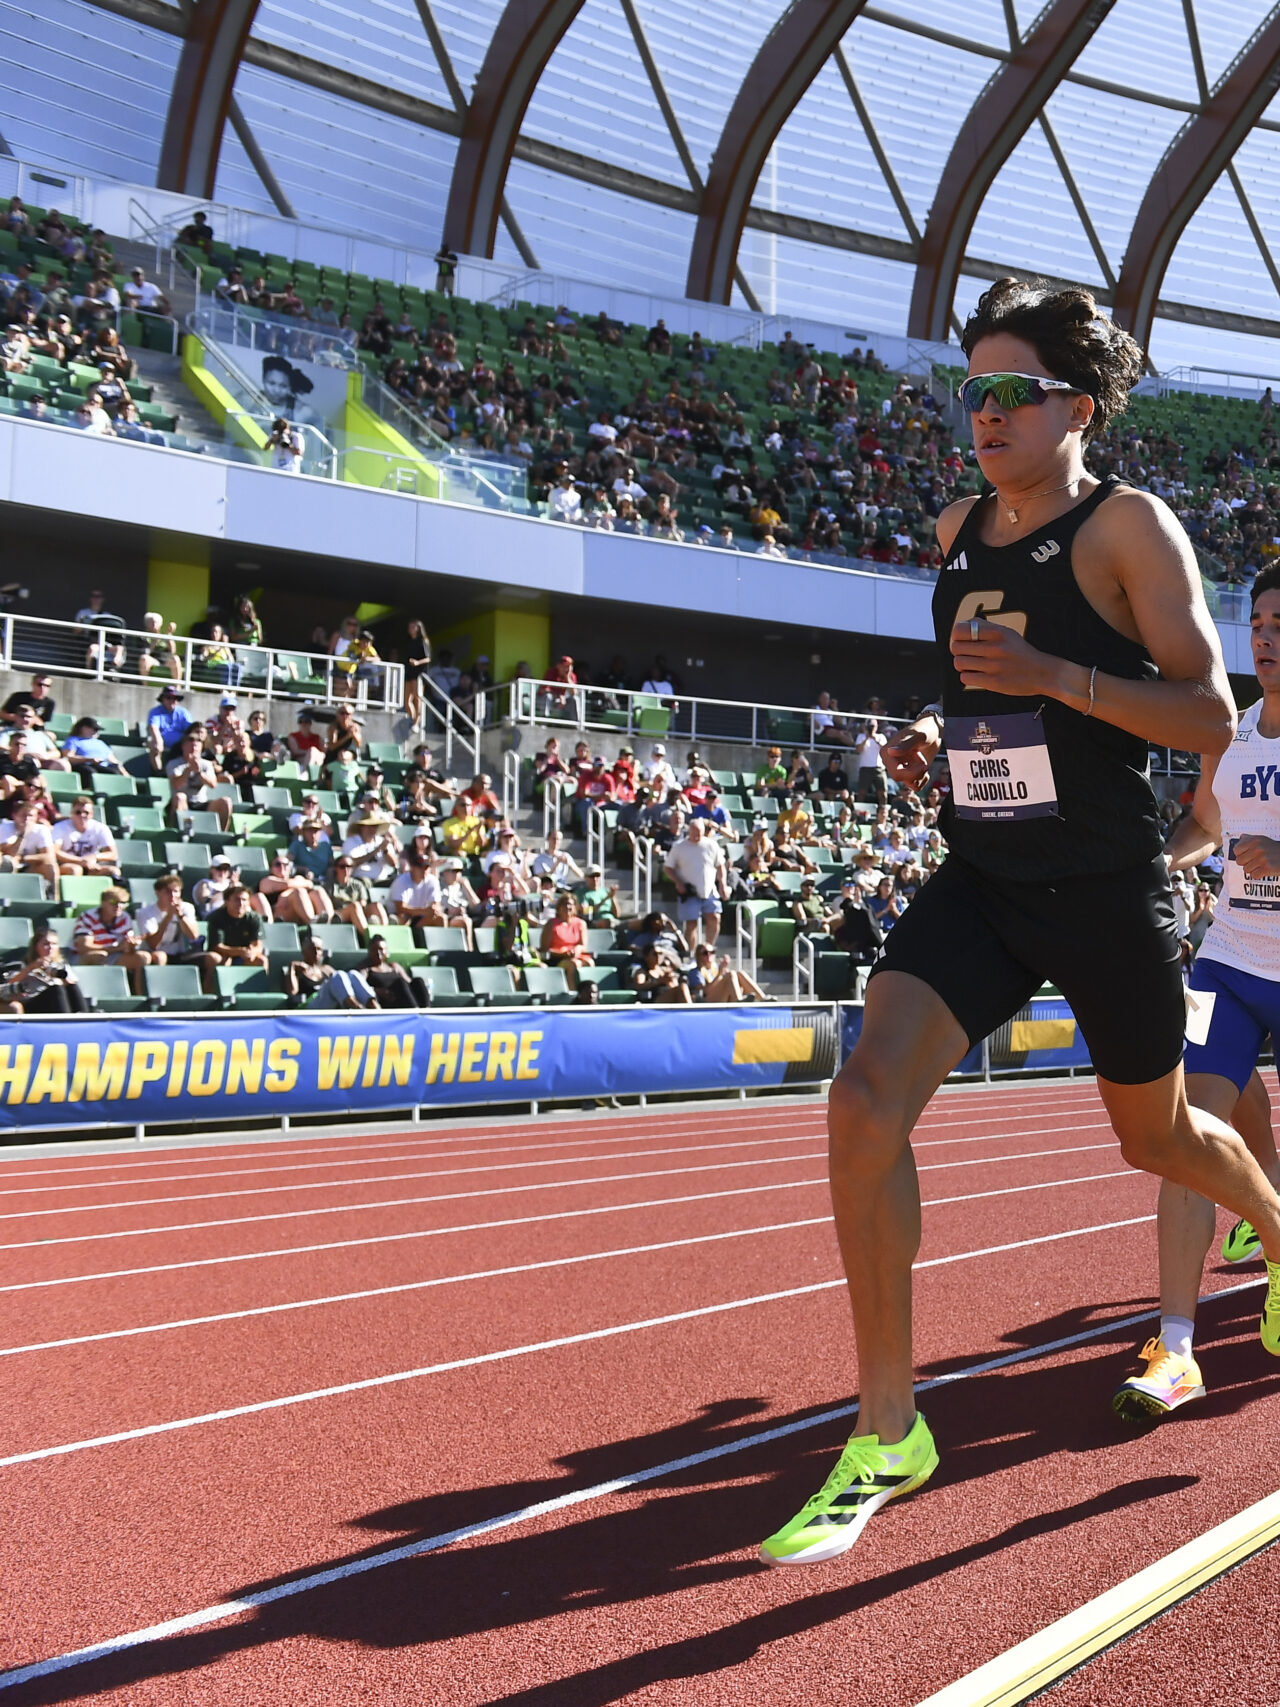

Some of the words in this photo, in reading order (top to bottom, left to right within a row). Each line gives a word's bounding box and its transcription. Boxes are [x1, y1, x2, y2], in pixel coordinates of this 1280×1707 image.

[969, 759, 1010, 778] CHRIS
[967, 781, 1028, 801] CAUDILLO
[1243, 883, 1280, 898] CUTTING
[318, 1034, 415, 1090] WIN
[425, 1030, 544, 1084] HERE
